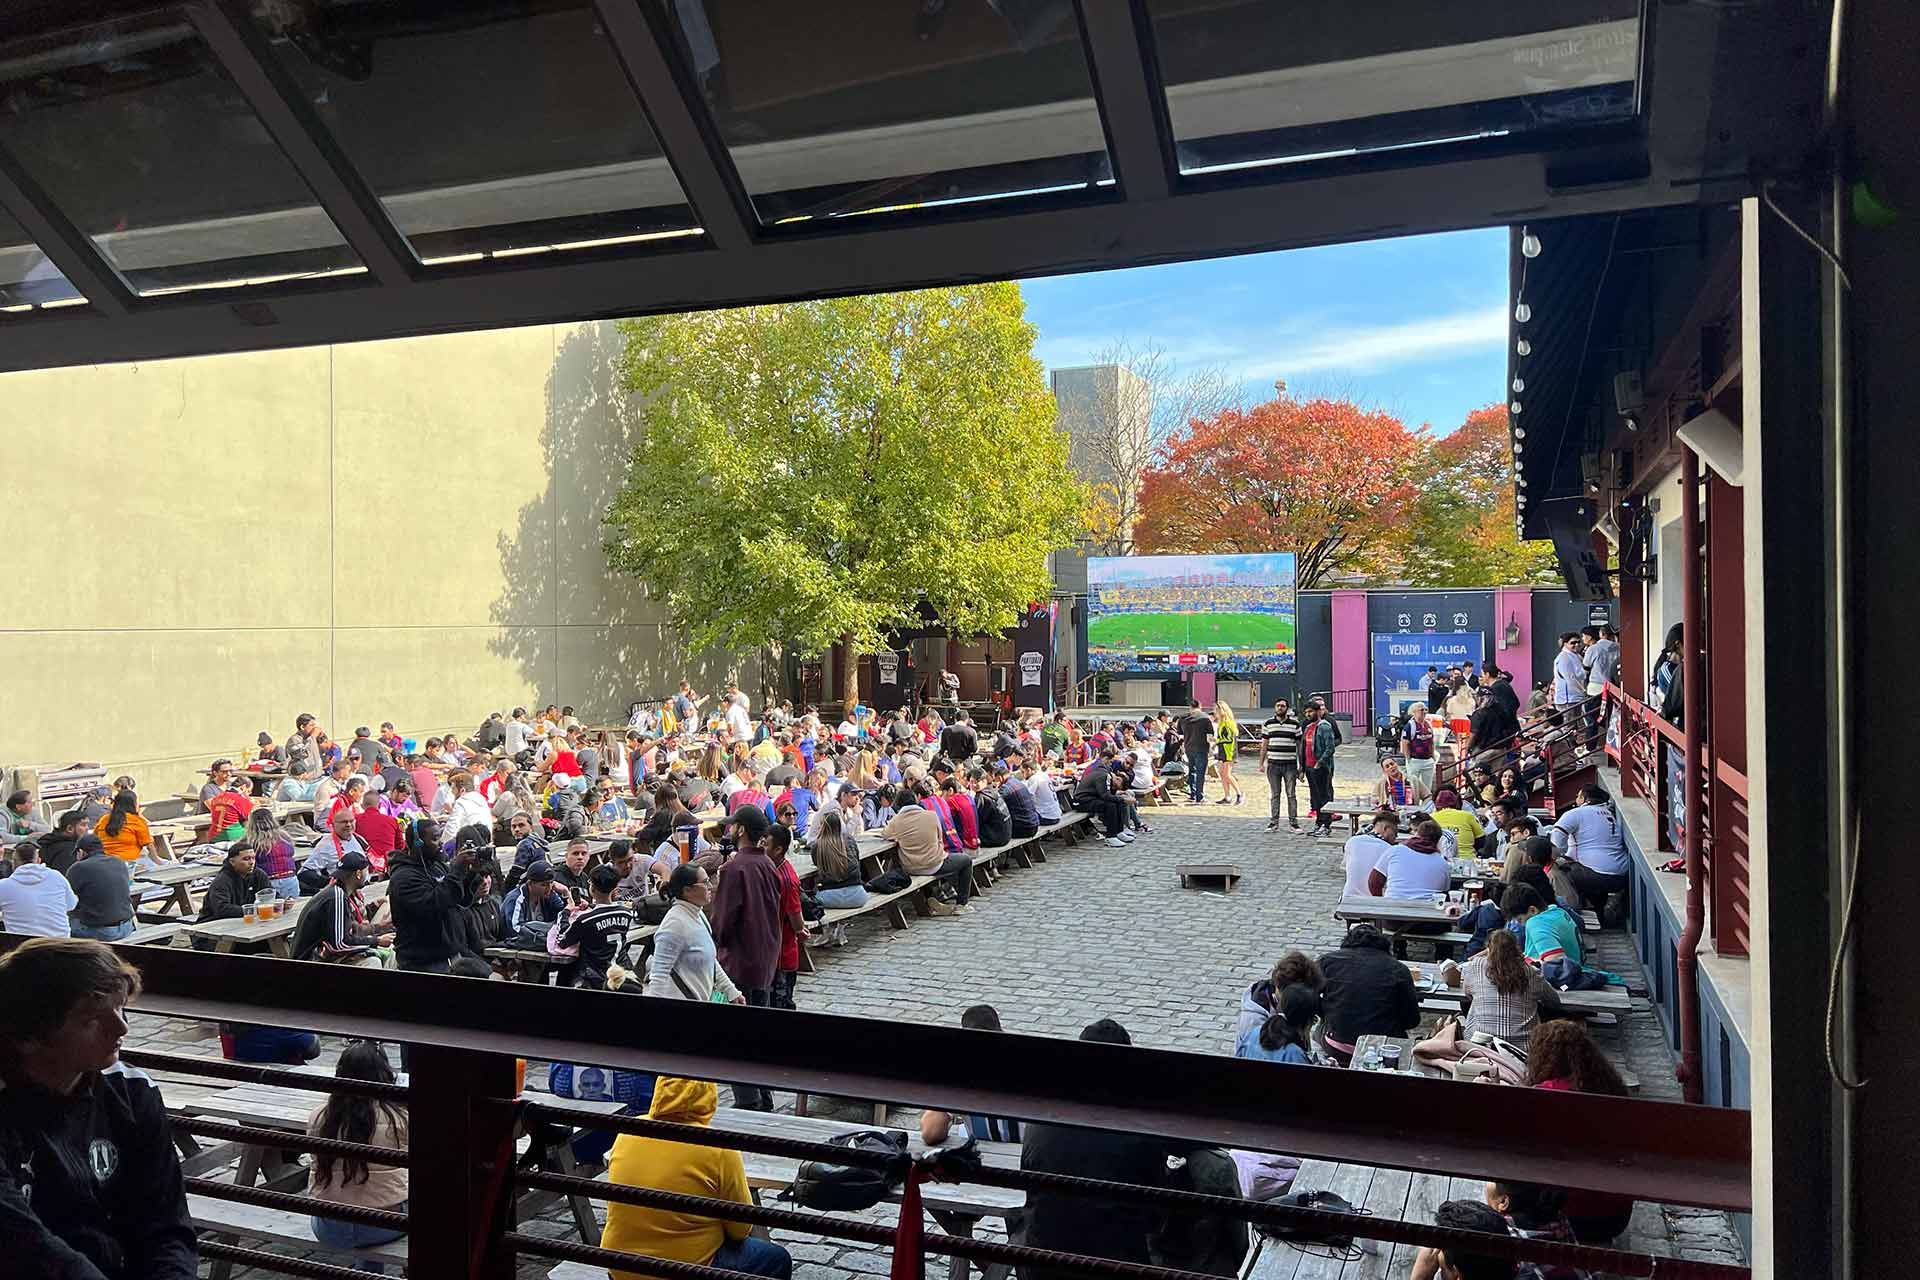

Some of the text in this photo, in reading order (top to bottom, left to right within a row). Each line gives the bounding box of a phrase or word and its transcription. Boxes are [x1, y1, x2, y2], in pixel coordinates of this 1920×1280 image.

[1389, 644, 1468, 655] VENADO LALIGA
[606, 933, 623, 964] 7
